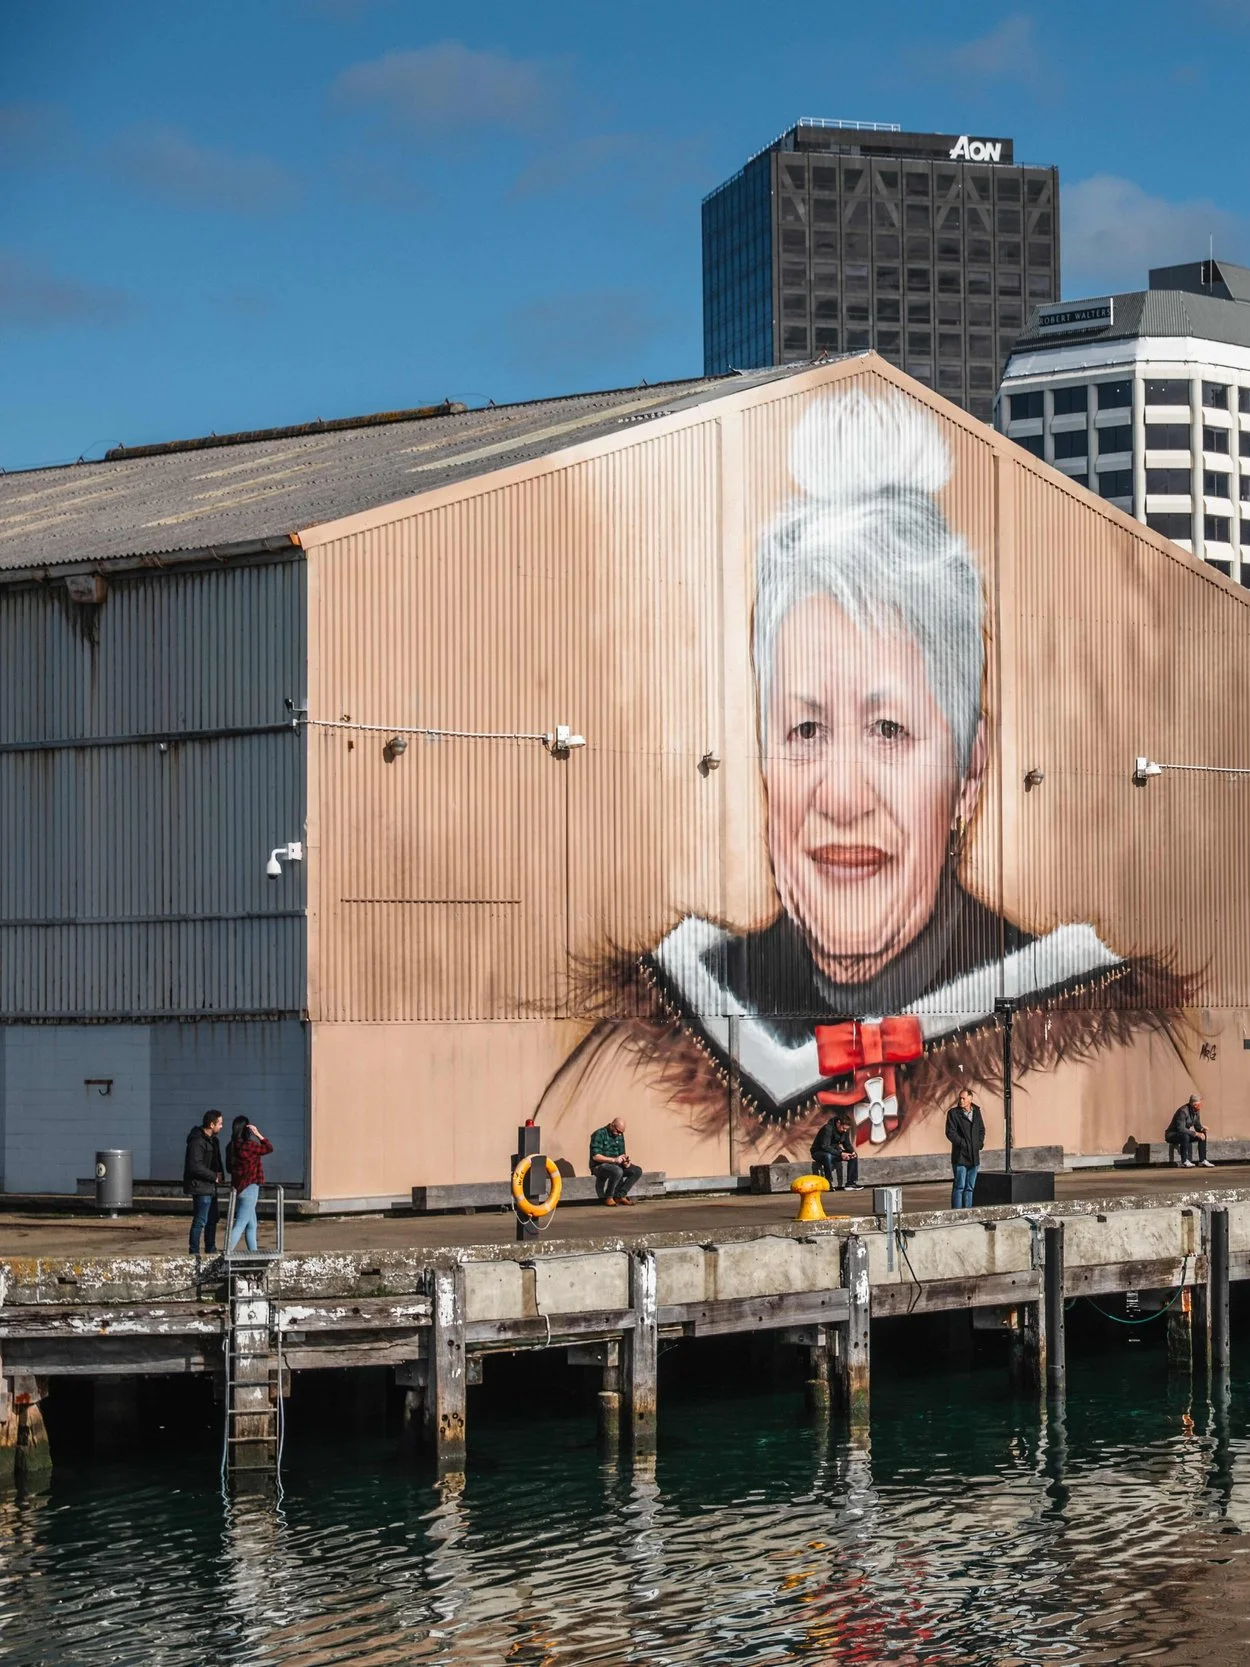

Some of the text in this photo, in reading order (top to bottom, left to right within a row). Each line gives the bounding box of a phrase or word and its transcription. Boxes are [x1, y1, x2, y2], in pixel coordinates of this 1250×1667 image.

[949, 135, 1002, 161] AON
[1039, 309, 1111, 325] ROBERT WALTERS
